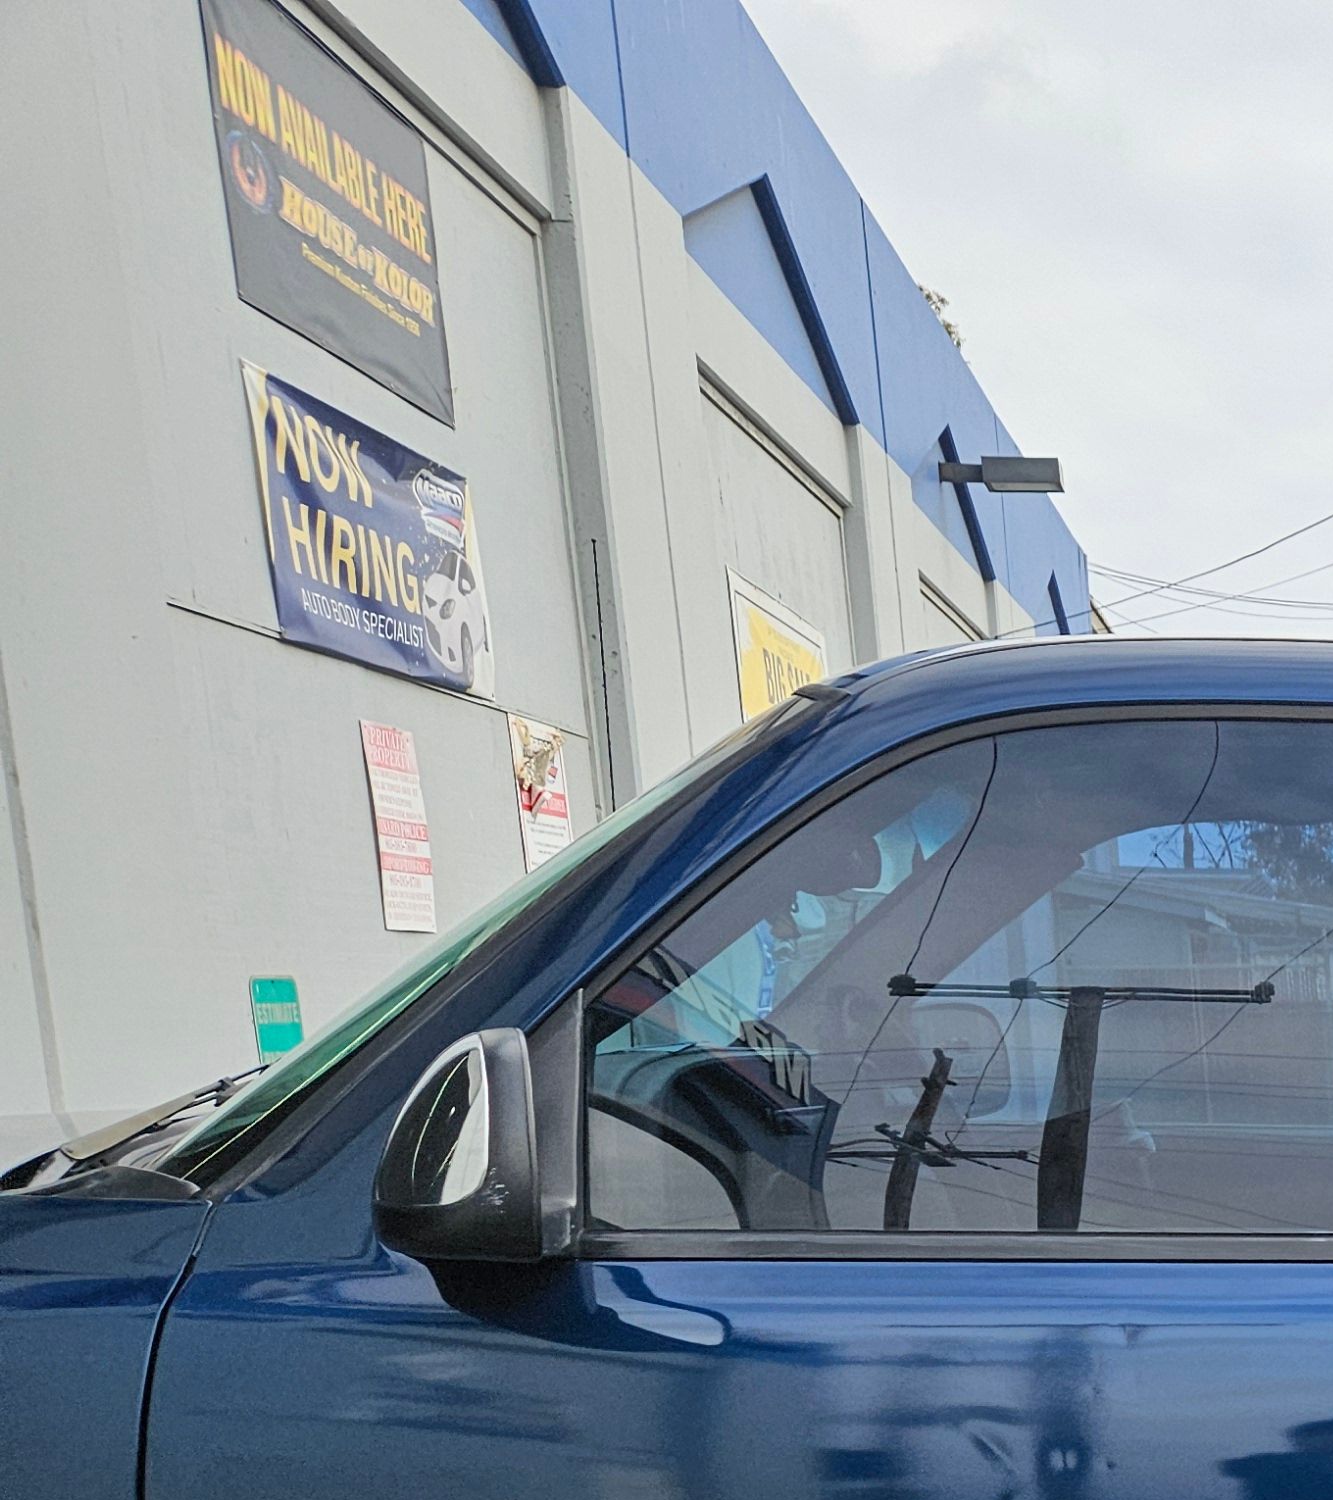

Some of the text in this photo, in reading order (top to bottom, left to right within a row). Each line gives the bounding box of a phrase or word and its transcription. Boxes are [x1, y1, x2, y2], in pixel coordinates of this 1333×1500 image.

[214, 32, 432, 265] NOW AVAILABLE HERE
[279, 175, 358, 269] HOUSE
[371, 245, 436, 328] KOLOR
[271, 395, 373, 508] NOW
[416, 475, 463, 511] Maaco
[282, 496, 422, 616] HIRING
[301, 588, 424, 649] AUTO BODY SPECIALIST
